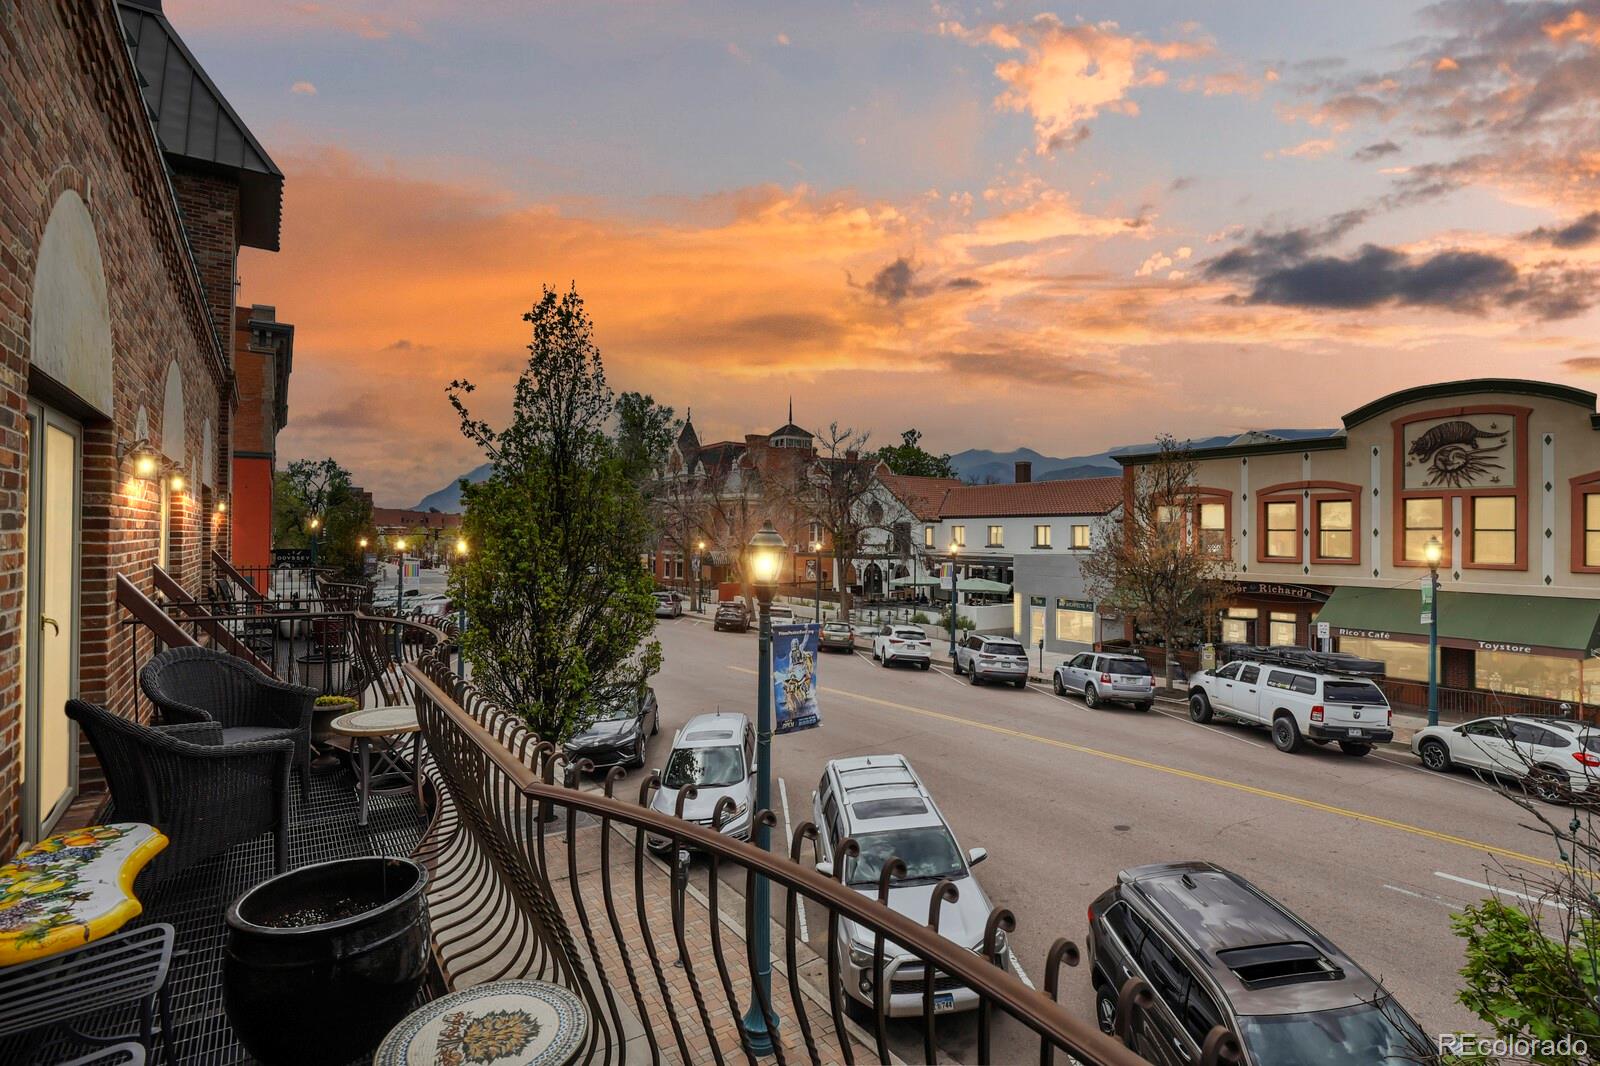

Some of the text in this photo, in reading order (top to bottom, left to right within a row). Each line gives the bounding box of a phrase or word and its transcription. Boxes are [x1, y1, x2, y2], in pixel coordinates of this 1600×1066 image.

[1259, 583, 1312, 599] Richard's
[1340, 628, 1391, 640] Rico's Café
[1478, 641, 1532, 653] Toystore
